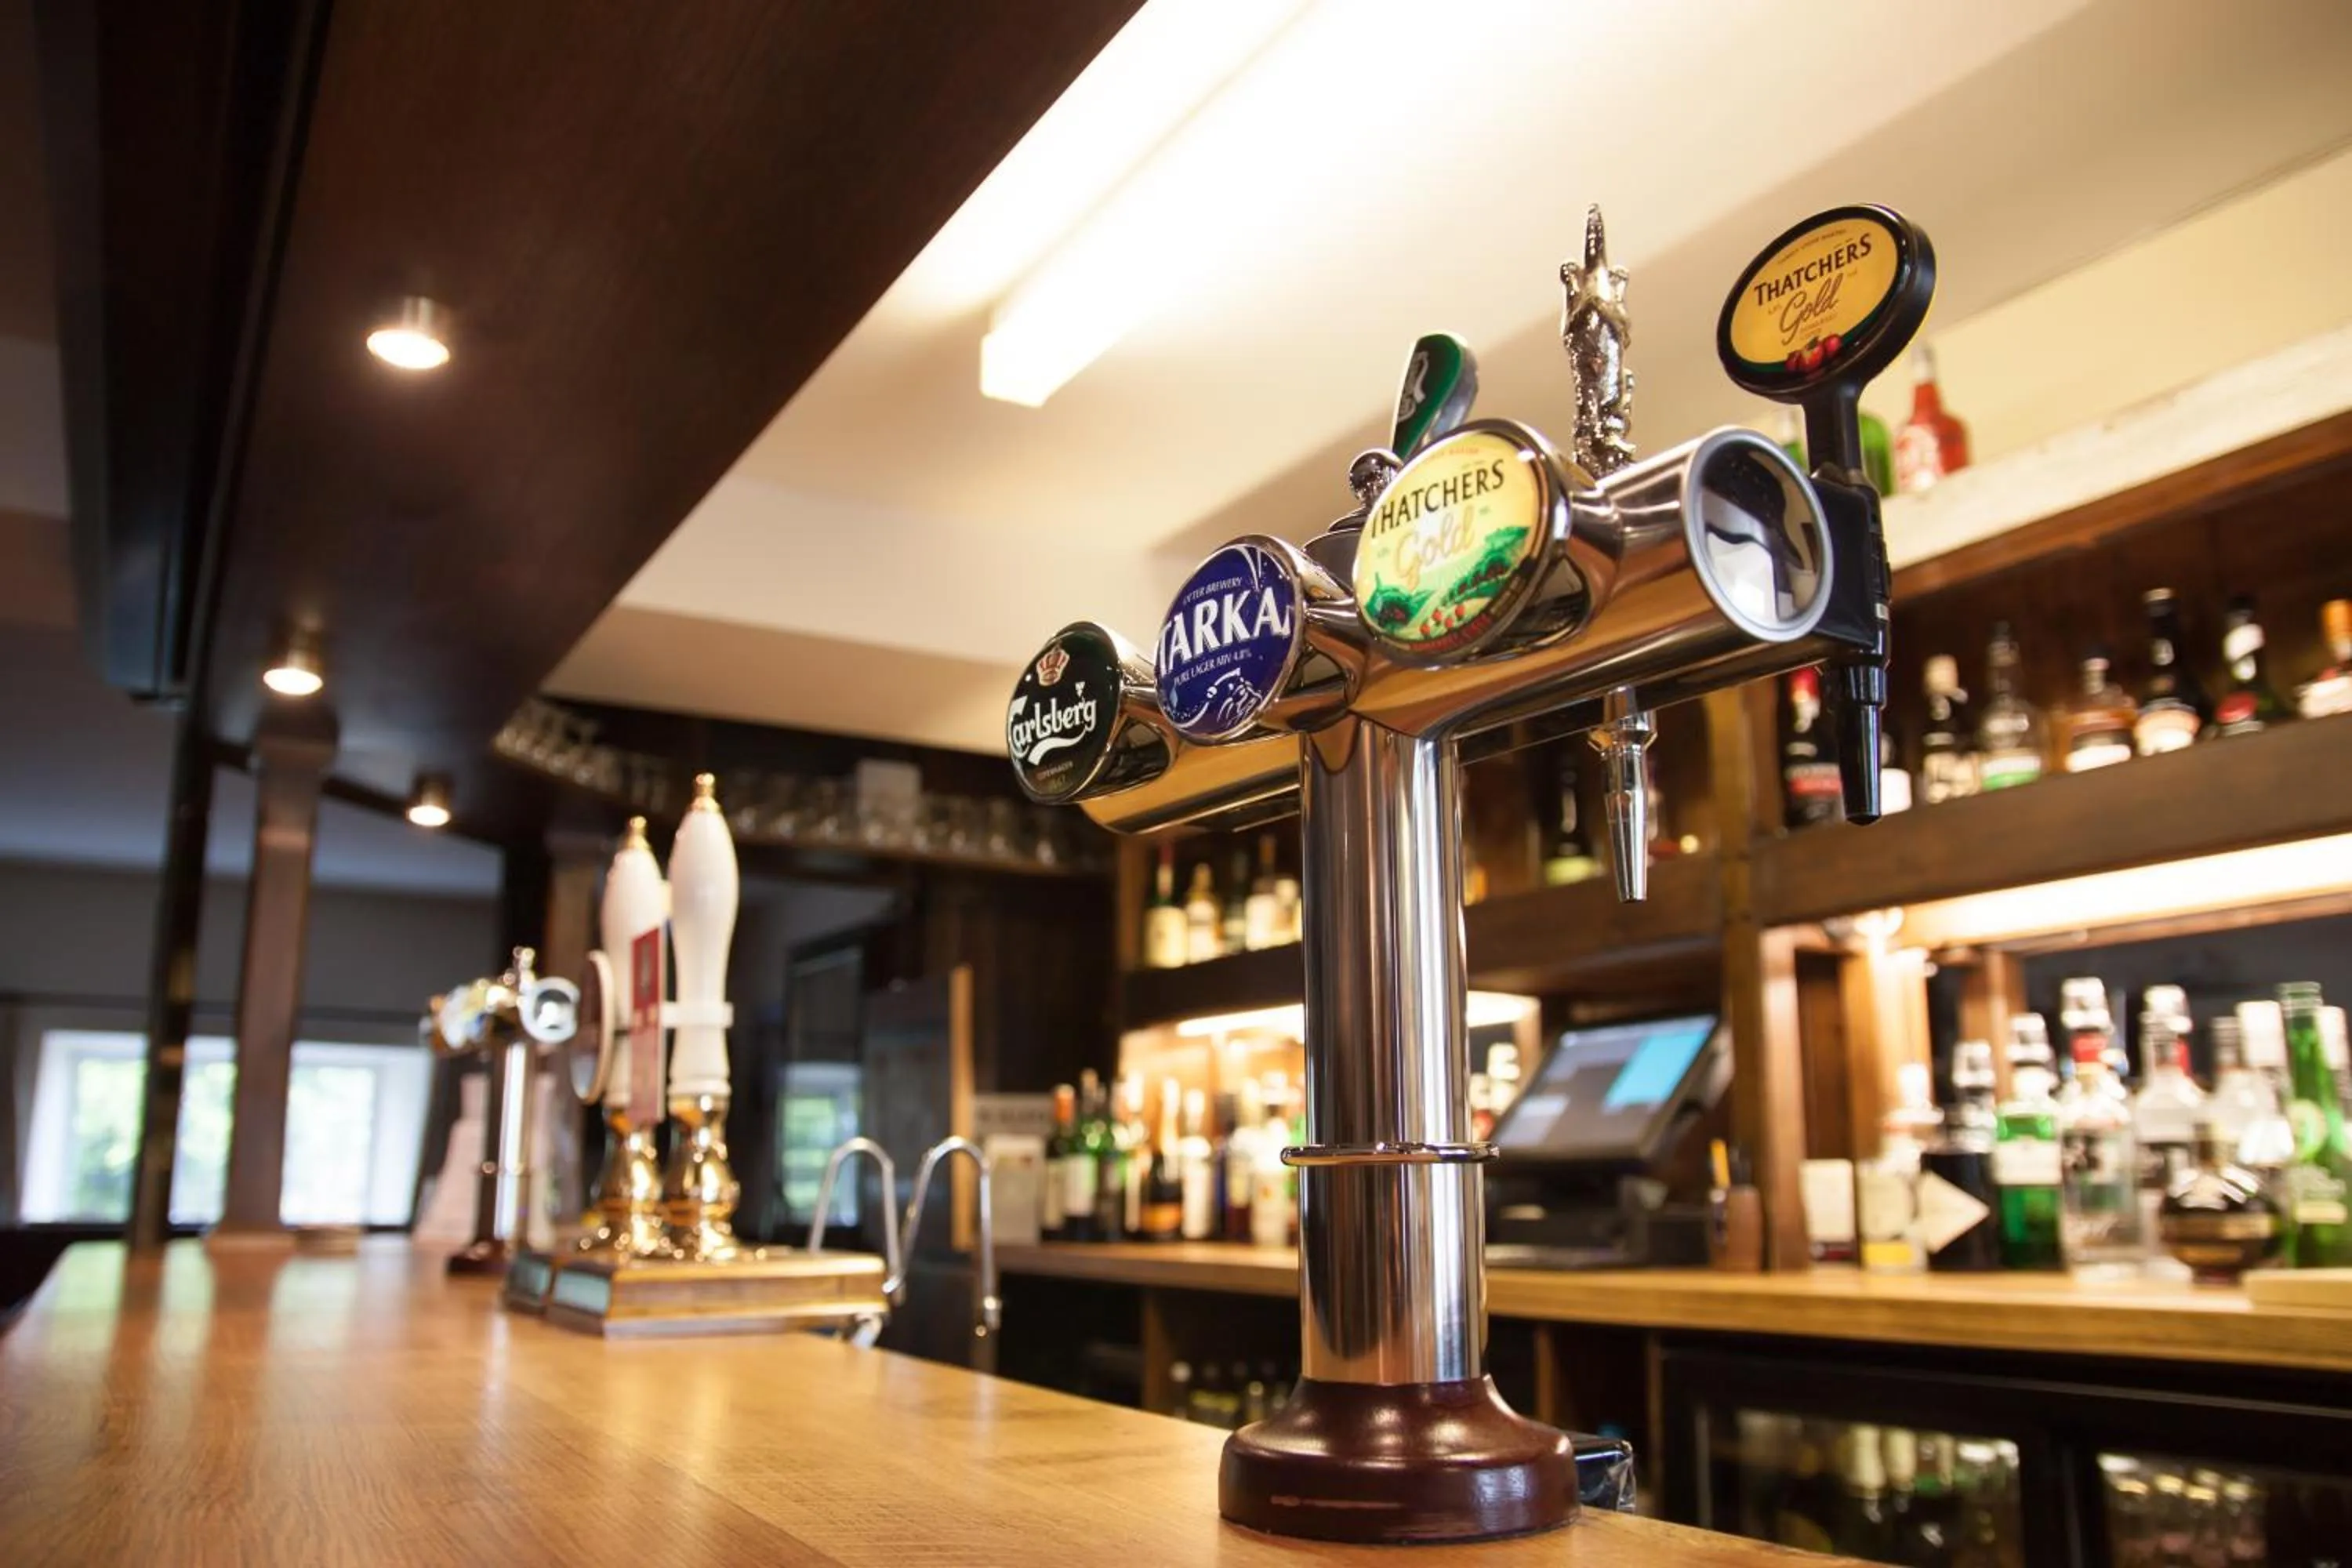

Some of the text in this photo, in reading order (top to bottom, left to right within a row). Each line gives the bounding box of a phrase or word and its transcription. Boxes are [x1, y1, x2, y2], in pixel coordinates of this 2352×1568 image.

[1754, 233, 1872, 307] THATCHERS
[1780, 272, 1843, 346] Gold
[1395, 505, 1475, 591] Gold
[1160, 586, 1283, 678] TARKA
[1008, 695, 1096, 764] Carlsberg
